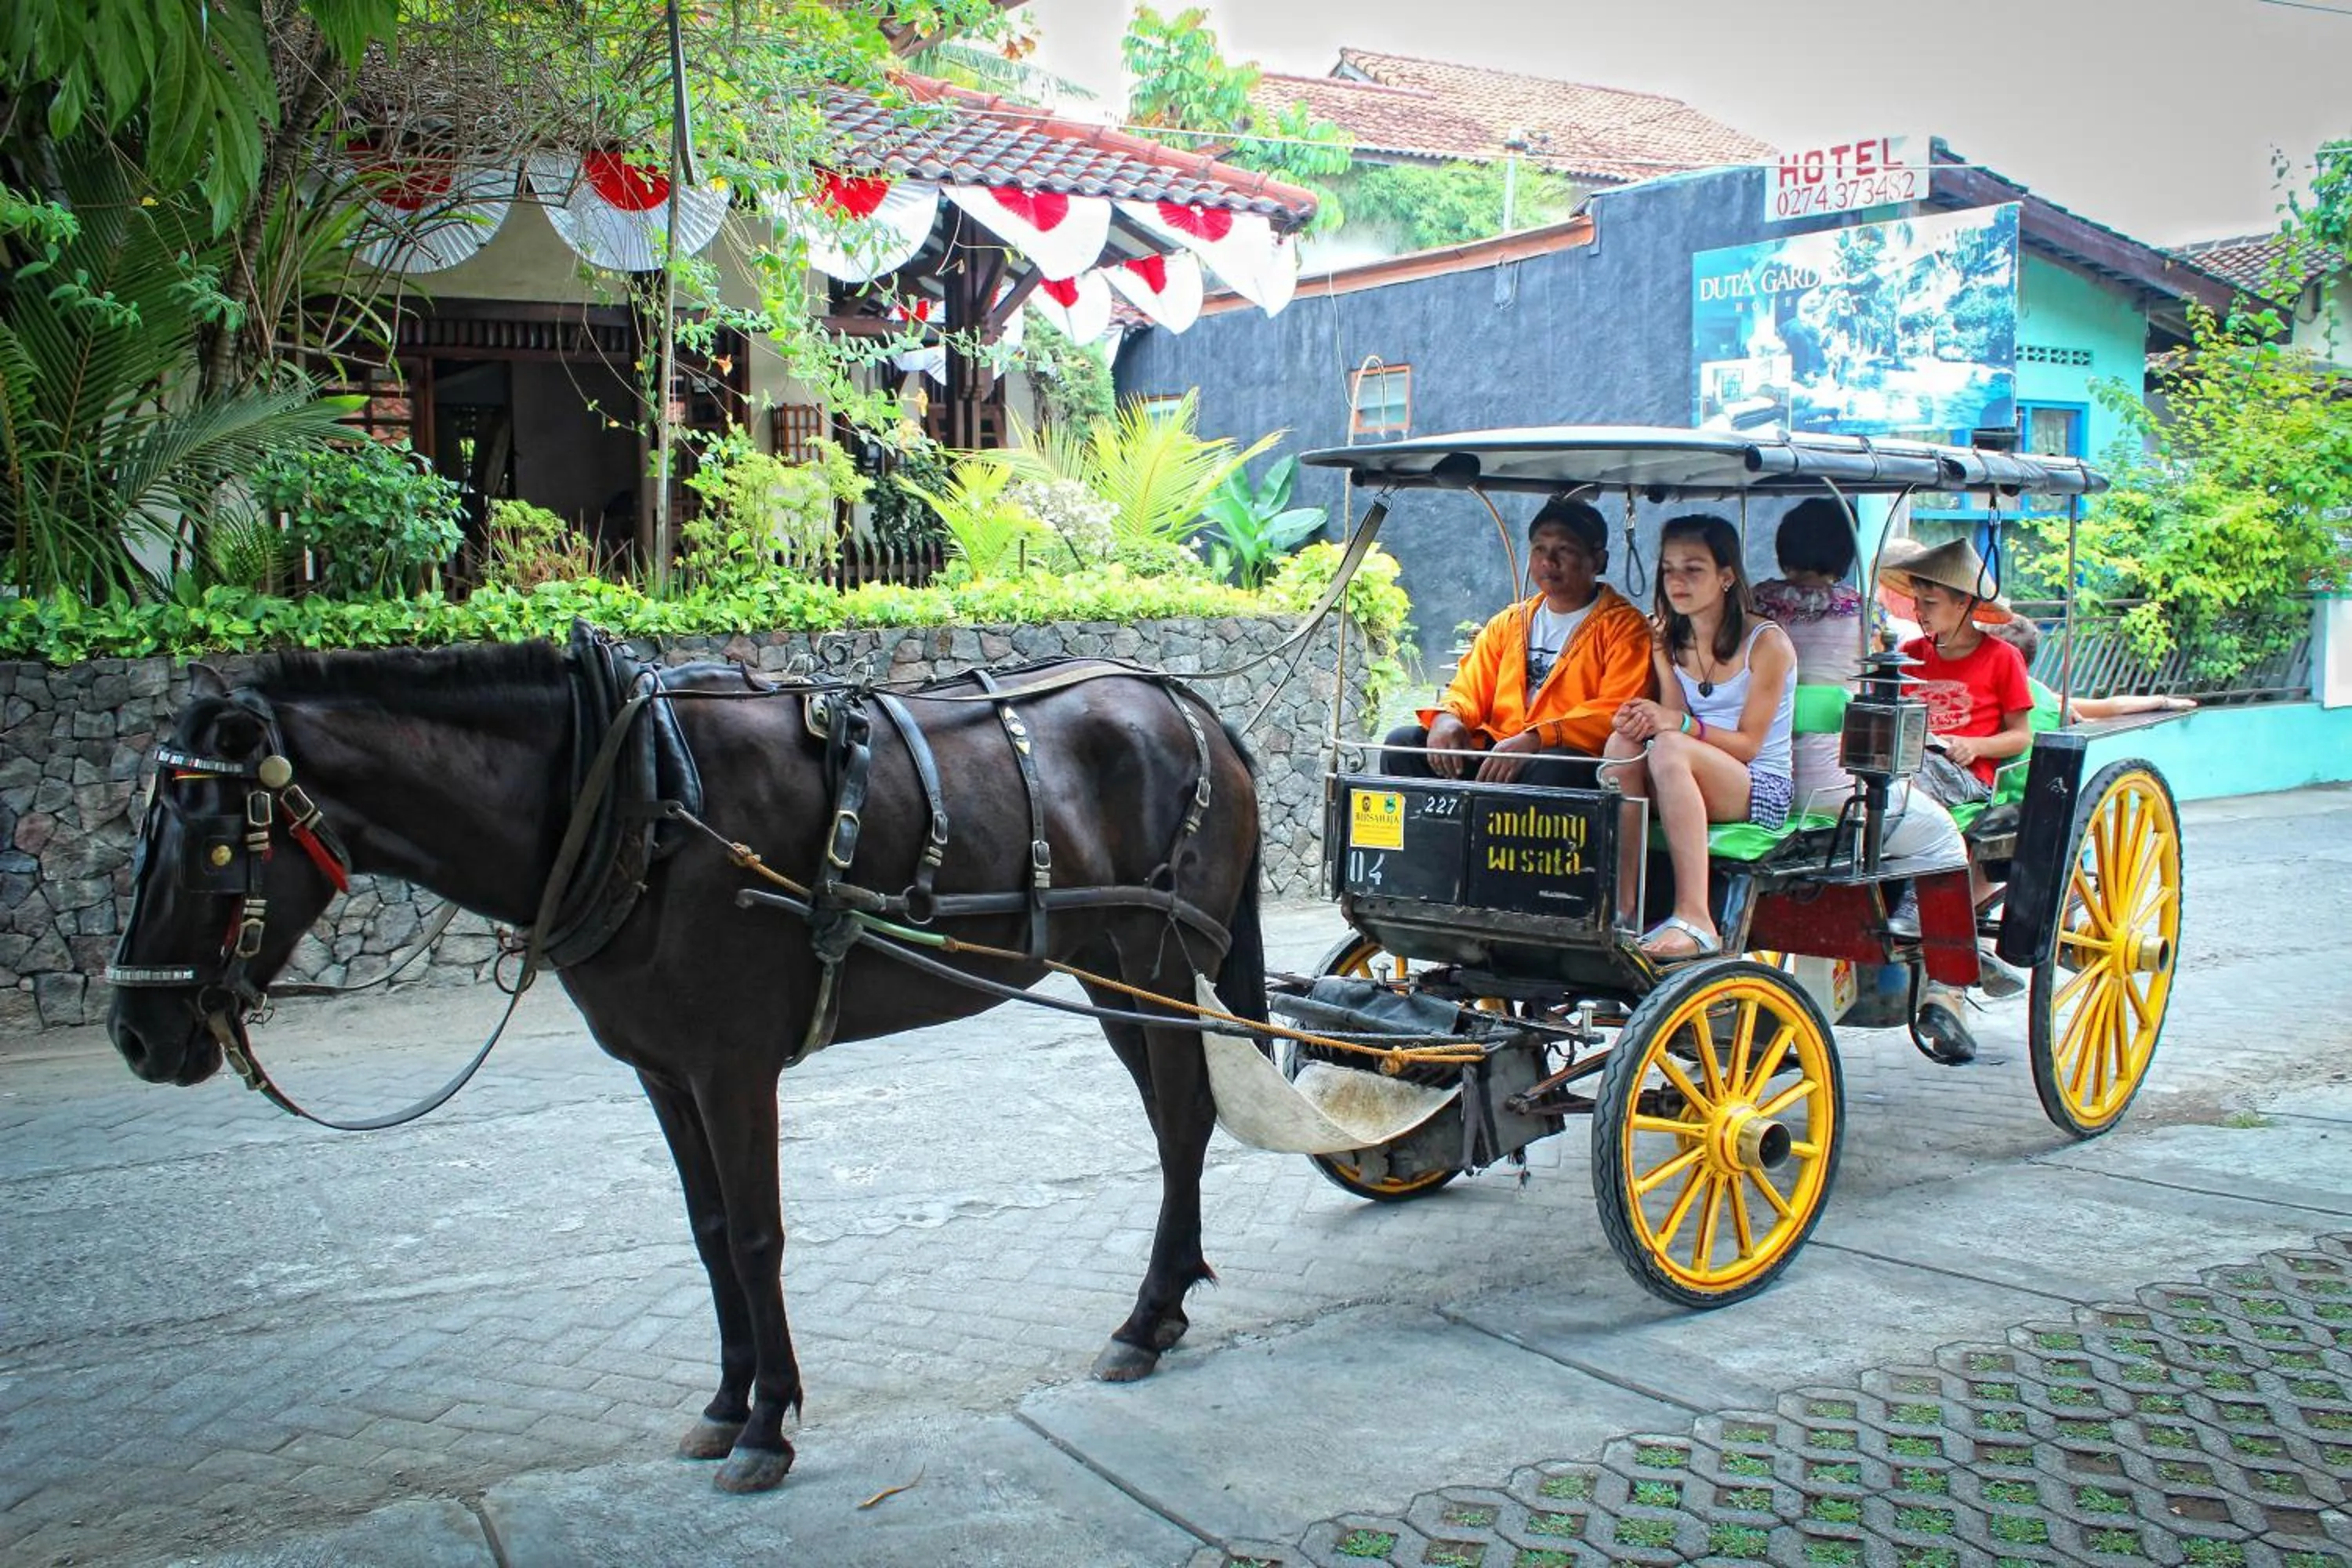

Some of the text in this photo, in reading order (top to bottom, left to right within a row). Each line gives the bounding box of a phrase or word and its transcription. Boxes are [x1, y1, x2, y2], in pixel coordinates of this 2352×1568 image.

[1779, 137, 1904, 188] HOTEL
[1699, 268, 1756, 302] DUTA
[1425, 795, 1457, 815] 227
[1487, 804, 1586, 848] andong
[1487, 846, 1581, 876] wisata
